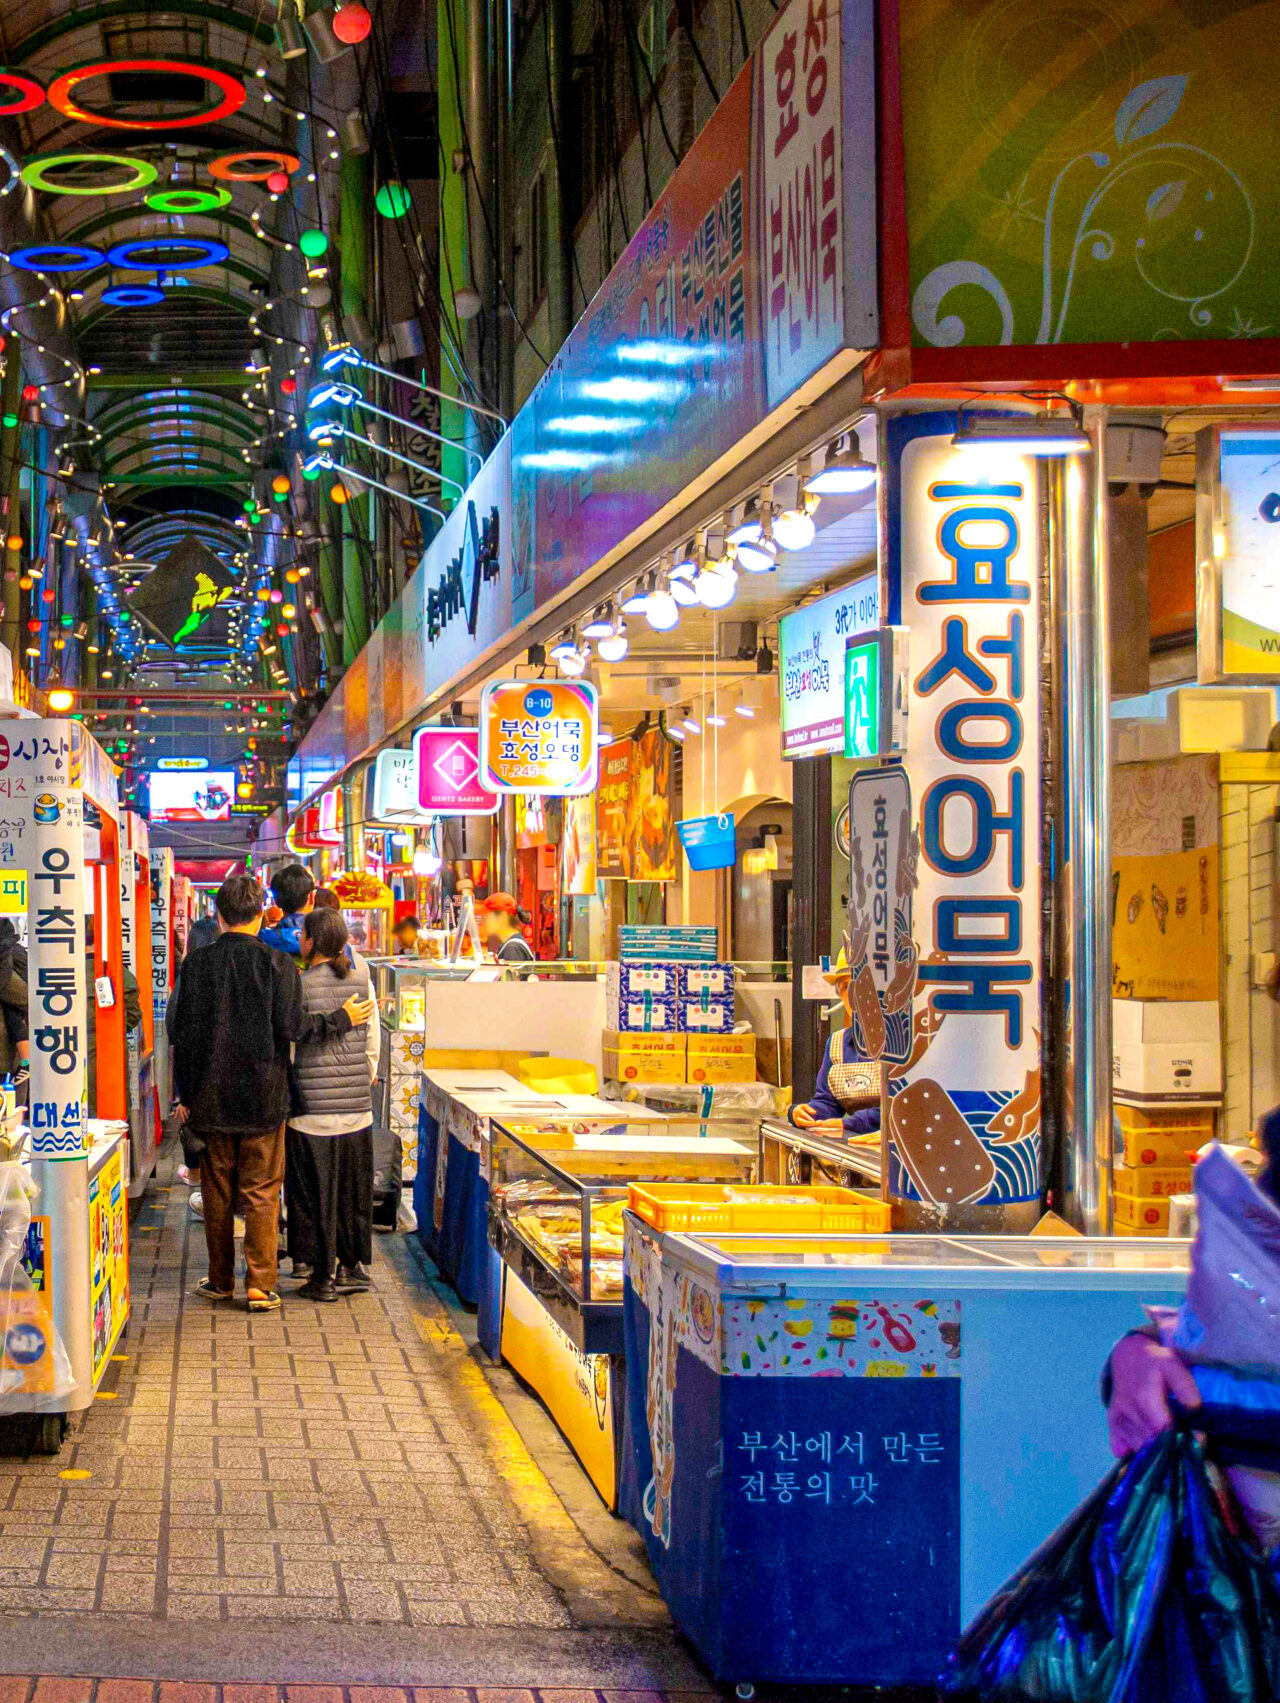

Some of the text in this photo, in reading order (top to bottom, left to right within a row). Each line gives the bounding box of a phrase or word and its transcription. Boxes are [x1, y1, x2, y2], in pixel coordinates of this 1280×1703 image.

[526, 697, 552, 709] B-10
[500, 720, 581, 740] 부산어묵
[500, 740, 580, 762] 효성오뎅
[916, 468, 1032, 1051] 효성어묵
[457, 795, 484, 803] BAKERY
[871, 793, 888, 982] 효성어묵
[151, 898, 167, 989] 우측통행
[33, 846, 78, 1076] 우측통행
[33, 1101, 81, 1129] 대선
[737, 1430, 946, 1465] 부산에서 만든
[737, 1471, 879, 1505] 전통의 맛
